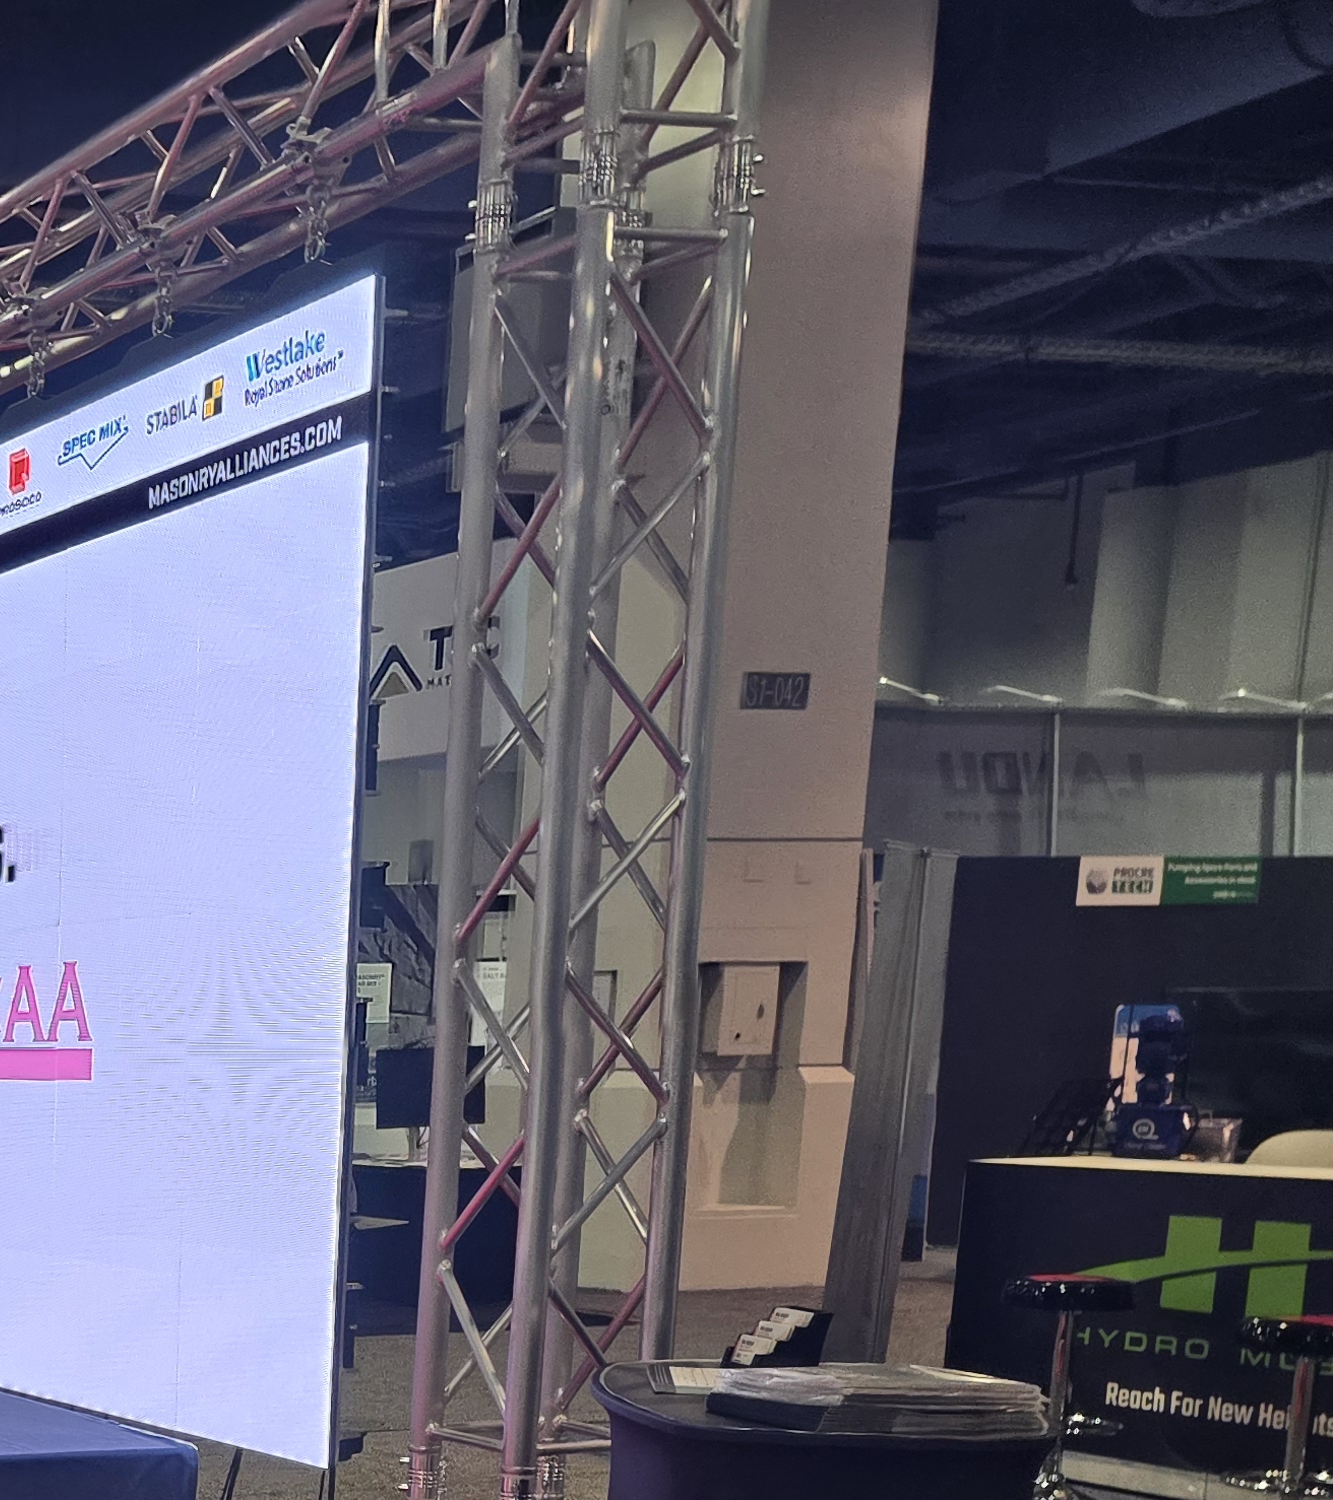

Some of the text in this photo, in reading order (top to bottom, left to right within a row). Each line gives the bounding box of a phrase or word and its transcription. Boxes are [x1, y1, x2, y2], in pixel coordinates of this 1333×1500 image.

[246, 330, 325, 382] Westlake
[146, 395, 198, 435] STABILA
[63, 432, 96, 458] SPEC
[148, 415, 343, 510] MASONRYALLIANCES.COM
[745, 677, 806, 708] S1-042
[1105, 1381, 1164, 1413] Reach
[1170, 1389, 1203, 1418] For
[1207, 1395, 1254, 1426] New
